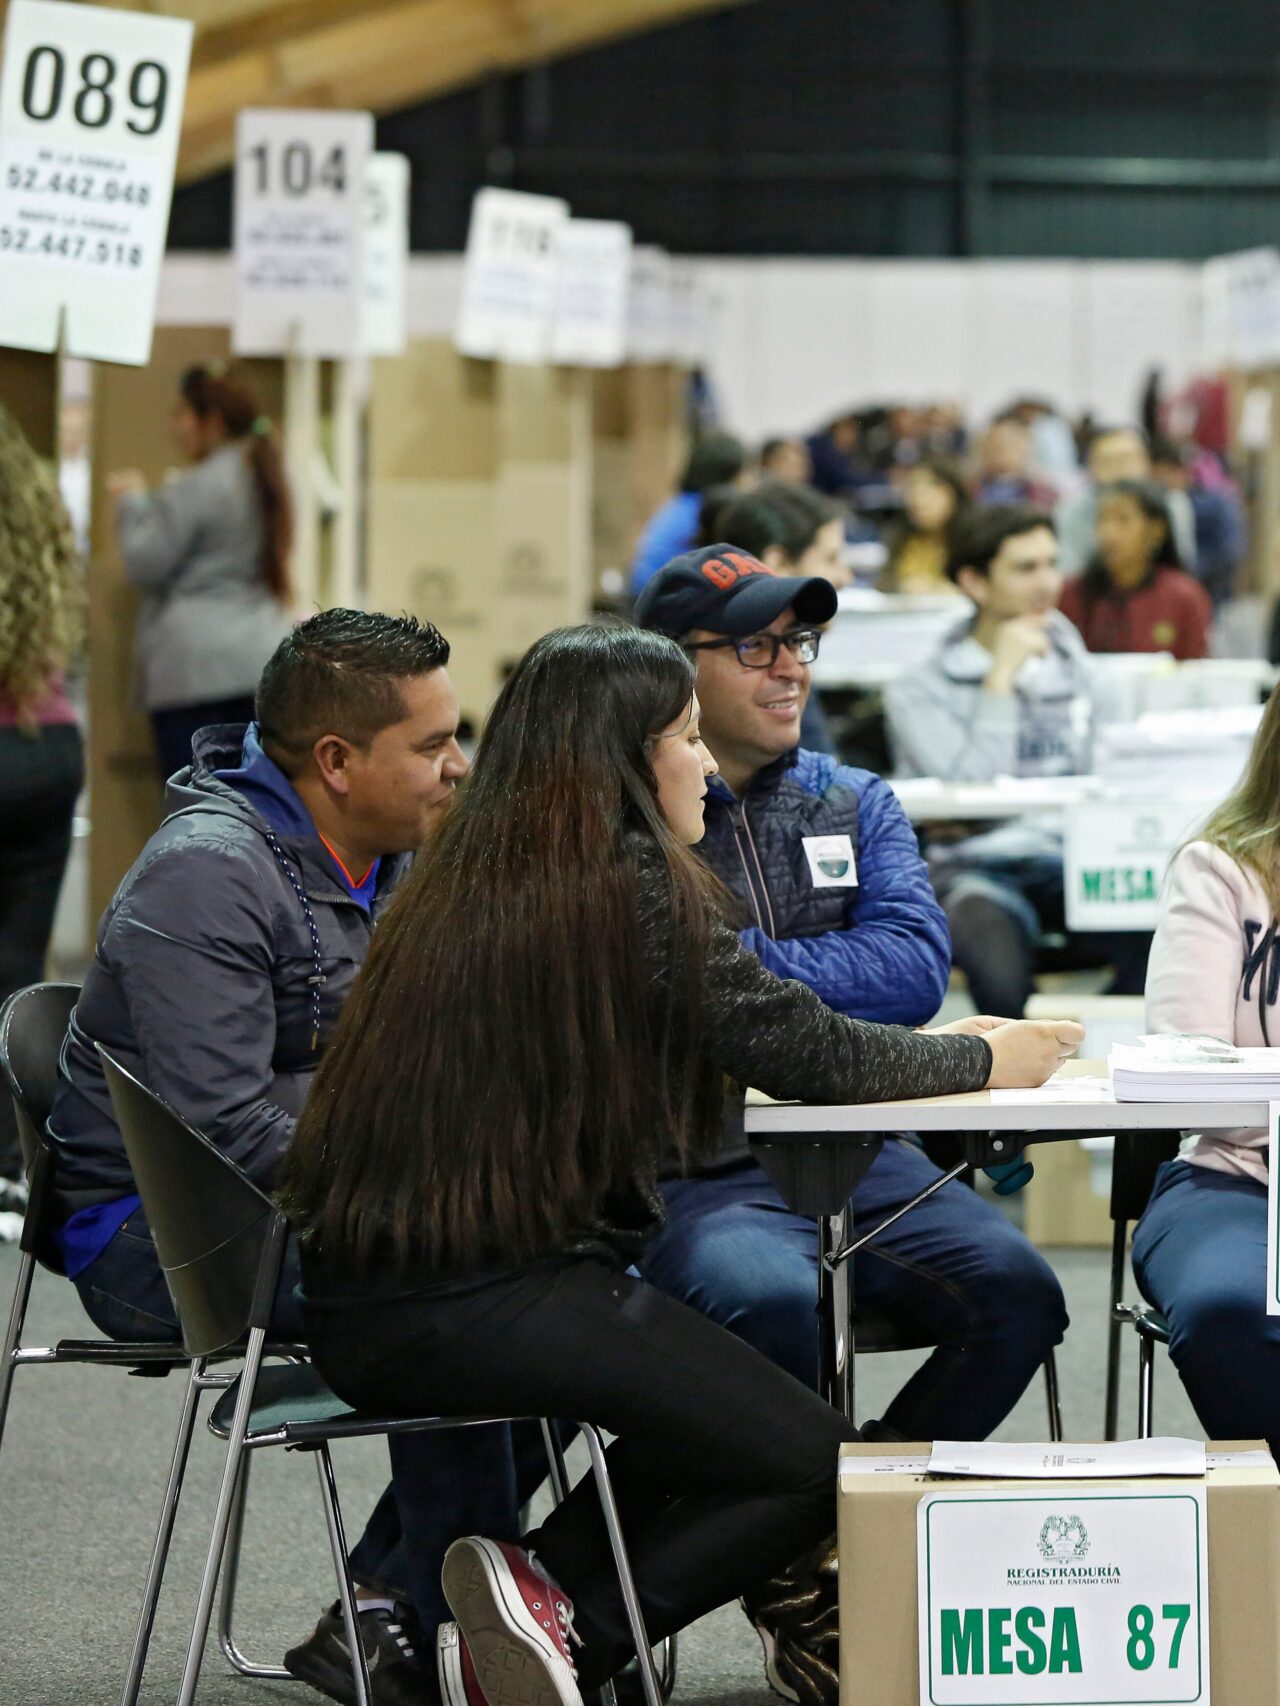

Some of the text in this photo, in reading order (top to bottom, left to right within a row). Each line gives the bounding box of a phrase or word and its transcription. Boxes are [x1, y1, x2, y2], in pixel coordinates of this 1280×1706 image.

[21, 46, 168, 136] 089
[251, 141, 347, 197] 104
[1081, 867, 1155, 903] MESA
[1007, 1563, 1121, 1578] REGISTRADURÍA
[940, 1604, 1191, 1675] MESA 87
